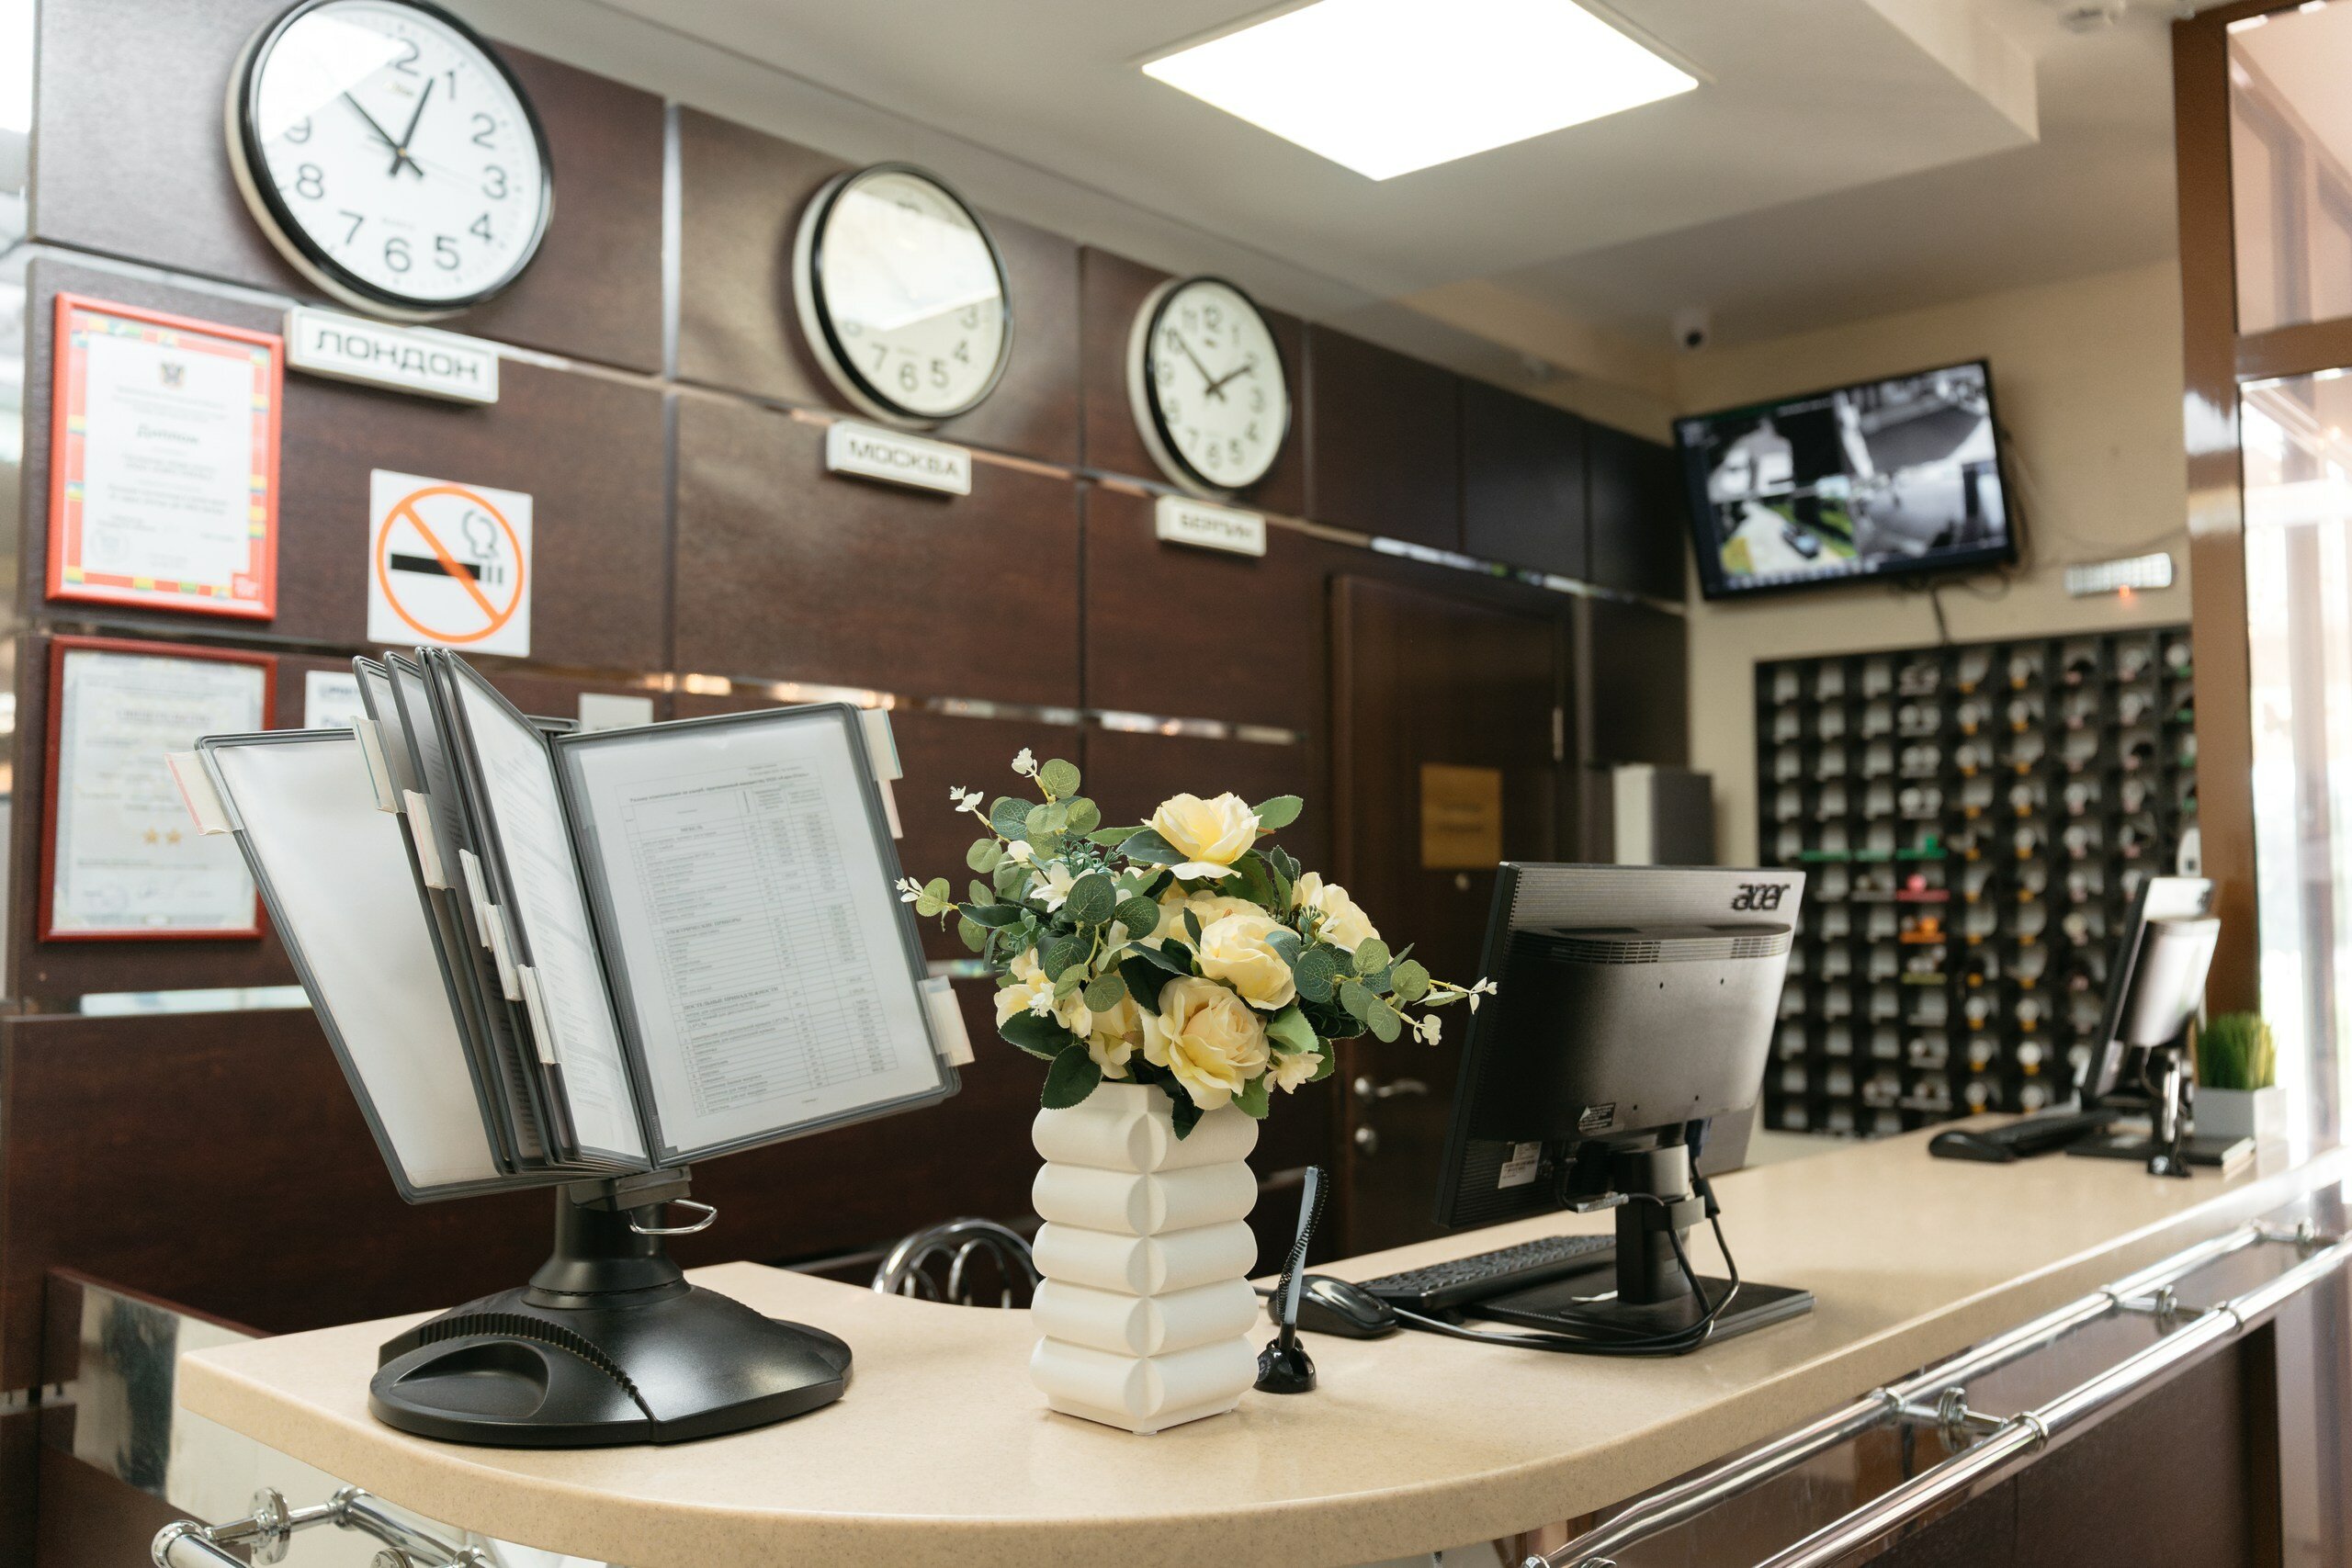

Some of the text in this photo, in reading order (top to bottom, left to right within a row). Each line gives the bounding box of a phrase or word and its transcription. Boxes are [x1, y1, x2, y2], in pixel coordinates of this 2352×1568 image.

[446, 70, 457, 102] 1
[471, 113, 496, 150] 2
[296, 163, 323, 200] 8
[481, 165, 507, 200] 3
[338, 209, 364, 245] 7
[469, 212, 492, 243] 4
[385, 237, 412, 274] 6
[435, 234, 459, 271] 5
[316, 329, 479, 381] ЛОНДОН
[871, 343, 888, 372] 7
[954, 339, 970, 365] 4
[898, 363, 919, 392] 6
[931, 357, 950, 389] 5
[848, 438, 959, 477] МОСКВА
[1732, 884, 1791, 910] acer
